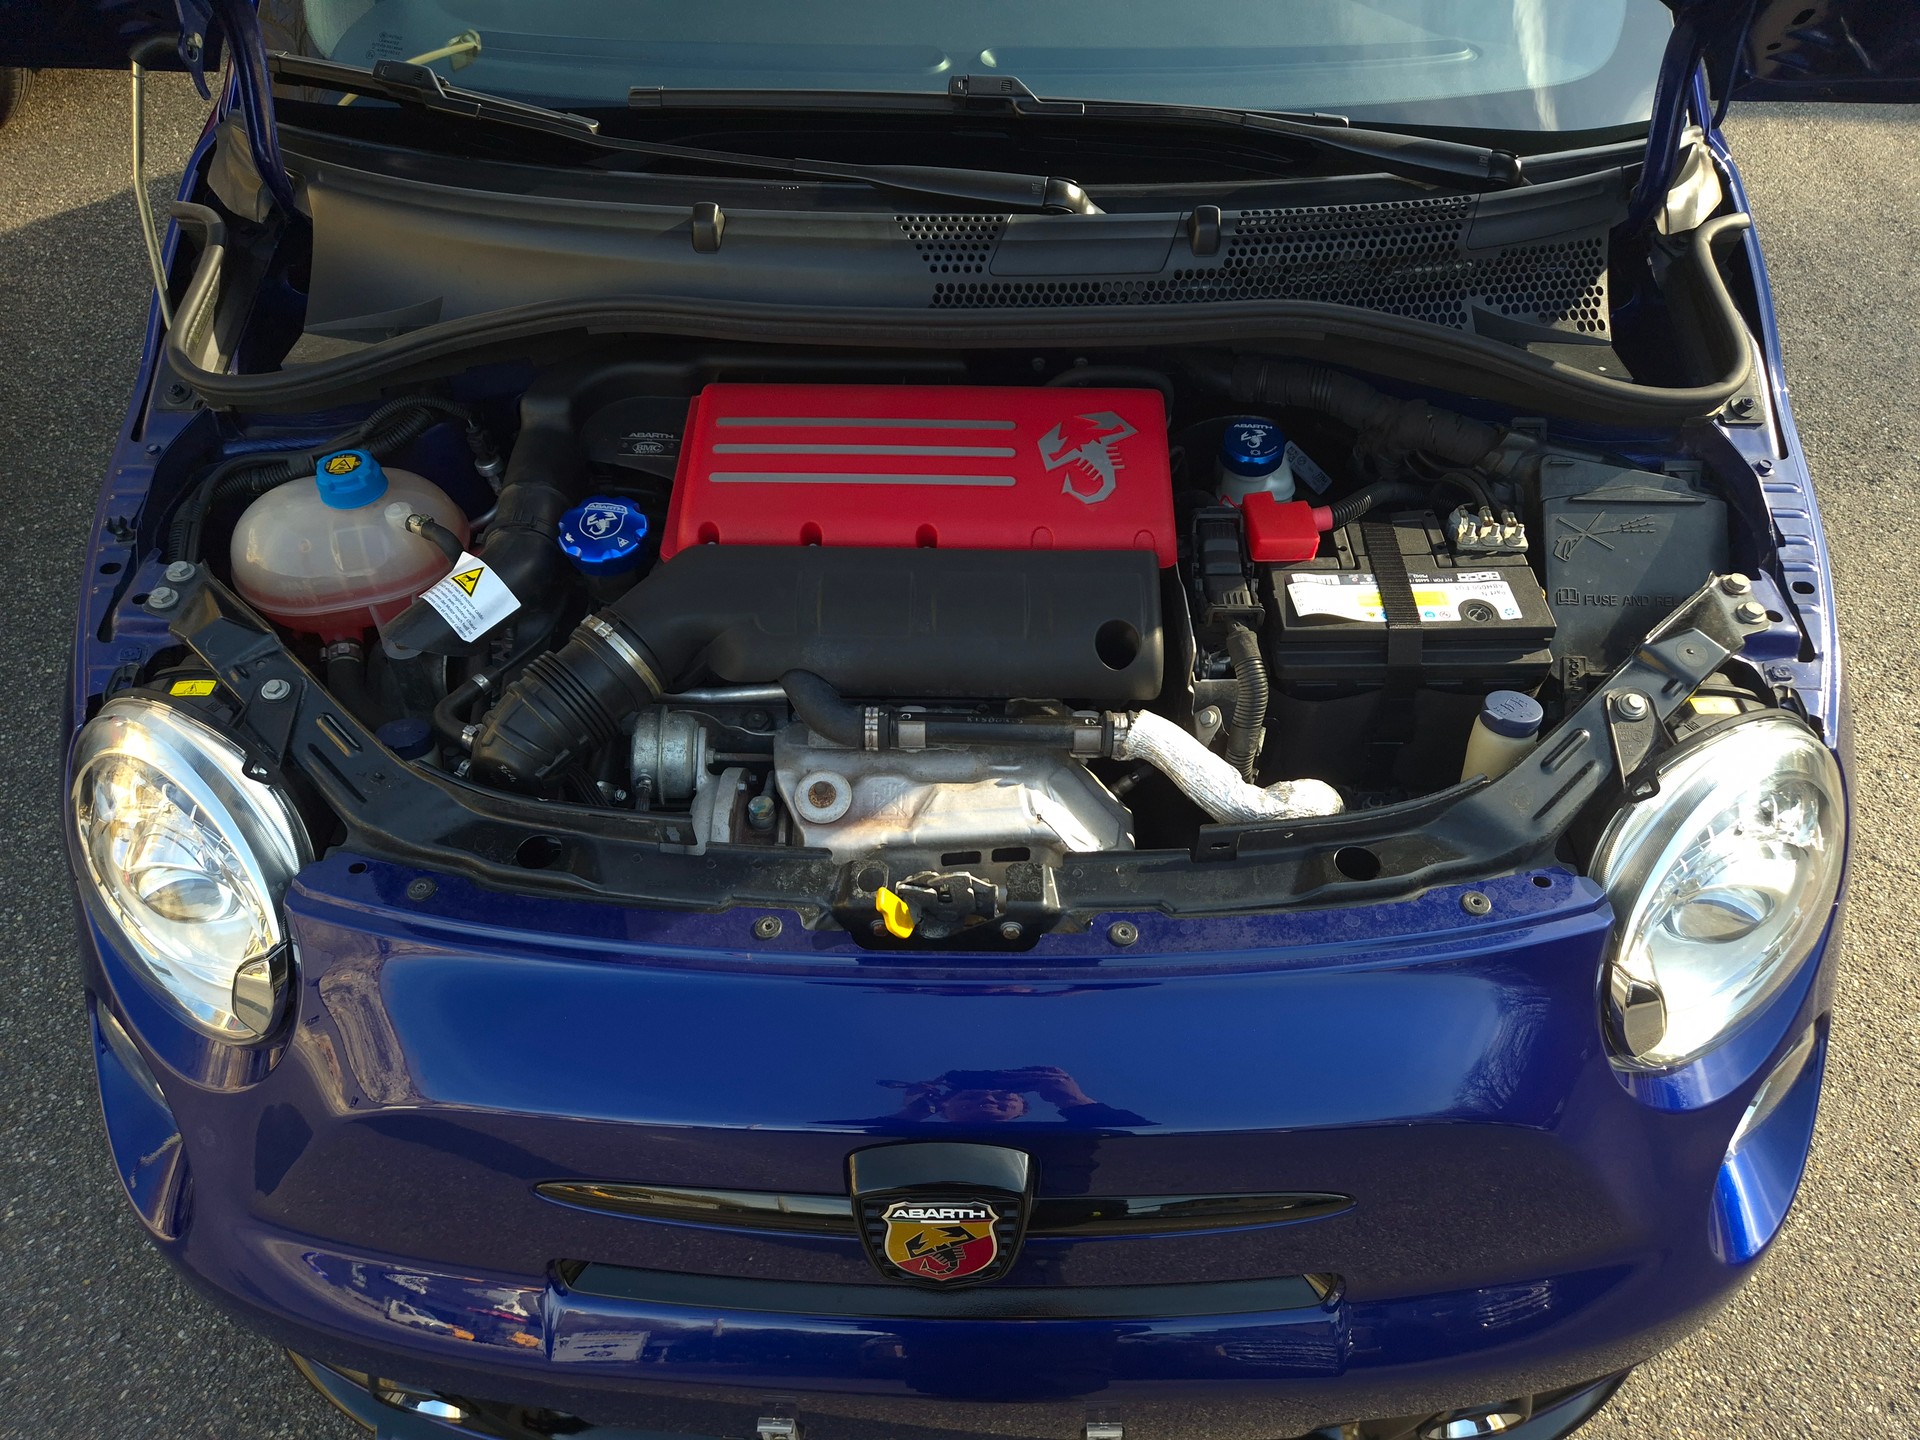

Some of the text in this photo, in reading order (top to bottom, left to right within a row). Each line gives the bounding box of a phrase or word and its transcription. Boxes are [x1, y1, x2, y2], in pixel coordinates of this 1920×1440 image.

[588, 503, 625, 512] ABARTH
[1584, 594, 1618, 606] FUSE
[1623, 594, 1649, 606] AND
[892, 1208, 986, 1219] ABARTH
